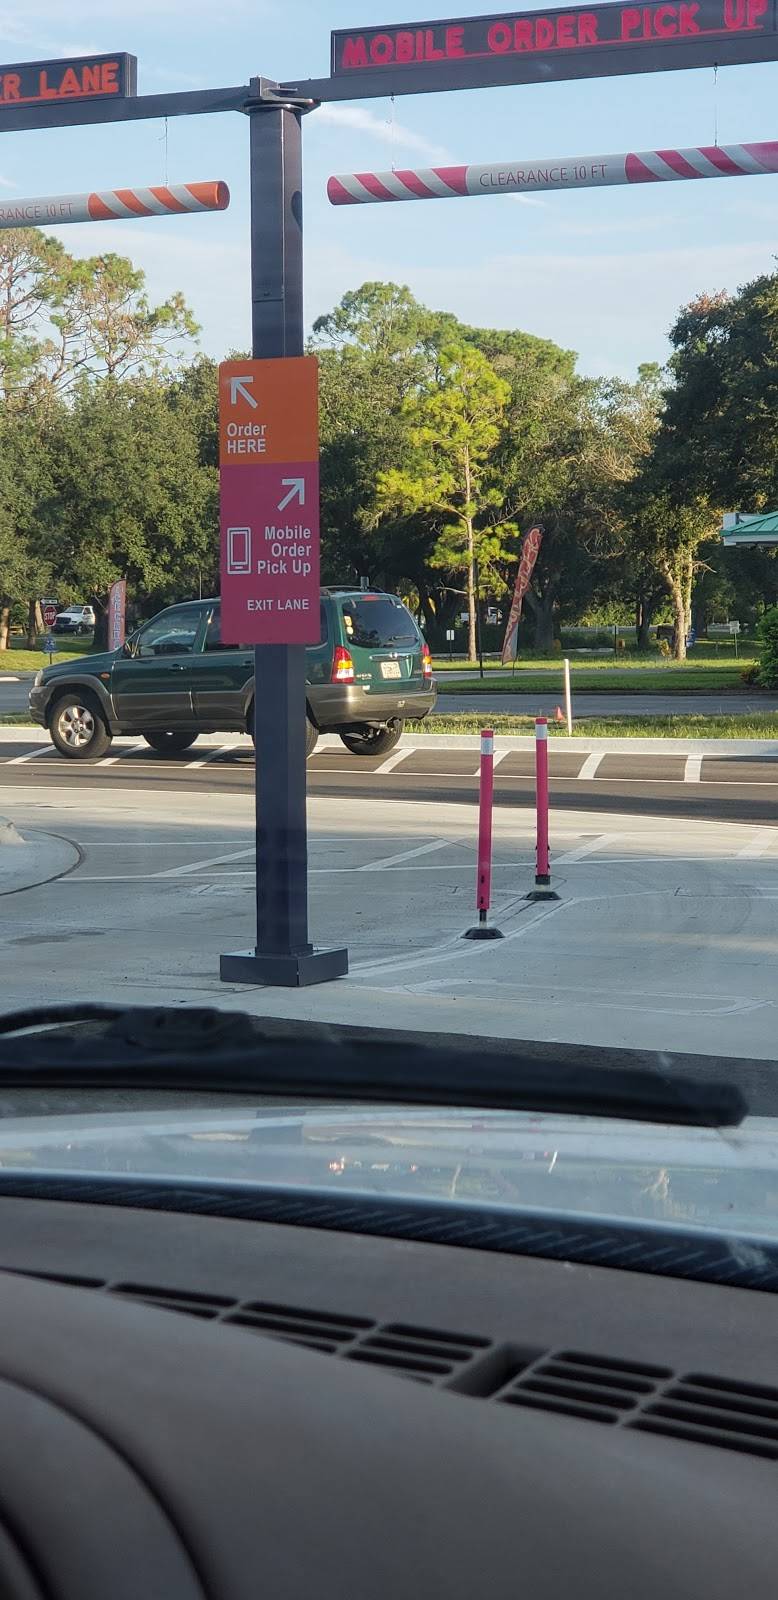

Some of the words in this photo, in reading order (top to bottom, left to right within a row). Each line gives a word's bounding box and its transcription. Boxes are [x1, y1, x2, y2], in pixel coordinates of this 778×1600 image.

[342, 27, 465, 68] MOBILE
[487, 13, 598, 52] ORDER
[621, 3, 700, 40] PICK
[723, 0, 768, 29] UP
[0, 73, 20, 99] R
[40, 62, 119, 98] LANE
[479, 168, 568, 187] CLEARANCE
[573, 166, 587, 181] 10
[591, 164, 608, 179] FT
[46, 204, 57, 217] 10
[60, 203, 73, 216] FT
[227, 422, 267, 437] Order
[227, 438, 266, 454] HERE
[264, 525, 311, 540] Mobile
[271, 543, 312, 557] Order
[257, 560, 287, 574] Pick
[292, 559, 311, 577] Up
[247, 599, 273, 611] EXIT
[277, 598, 309, 610] LANE
[44, 611, 56, 620] STOP
